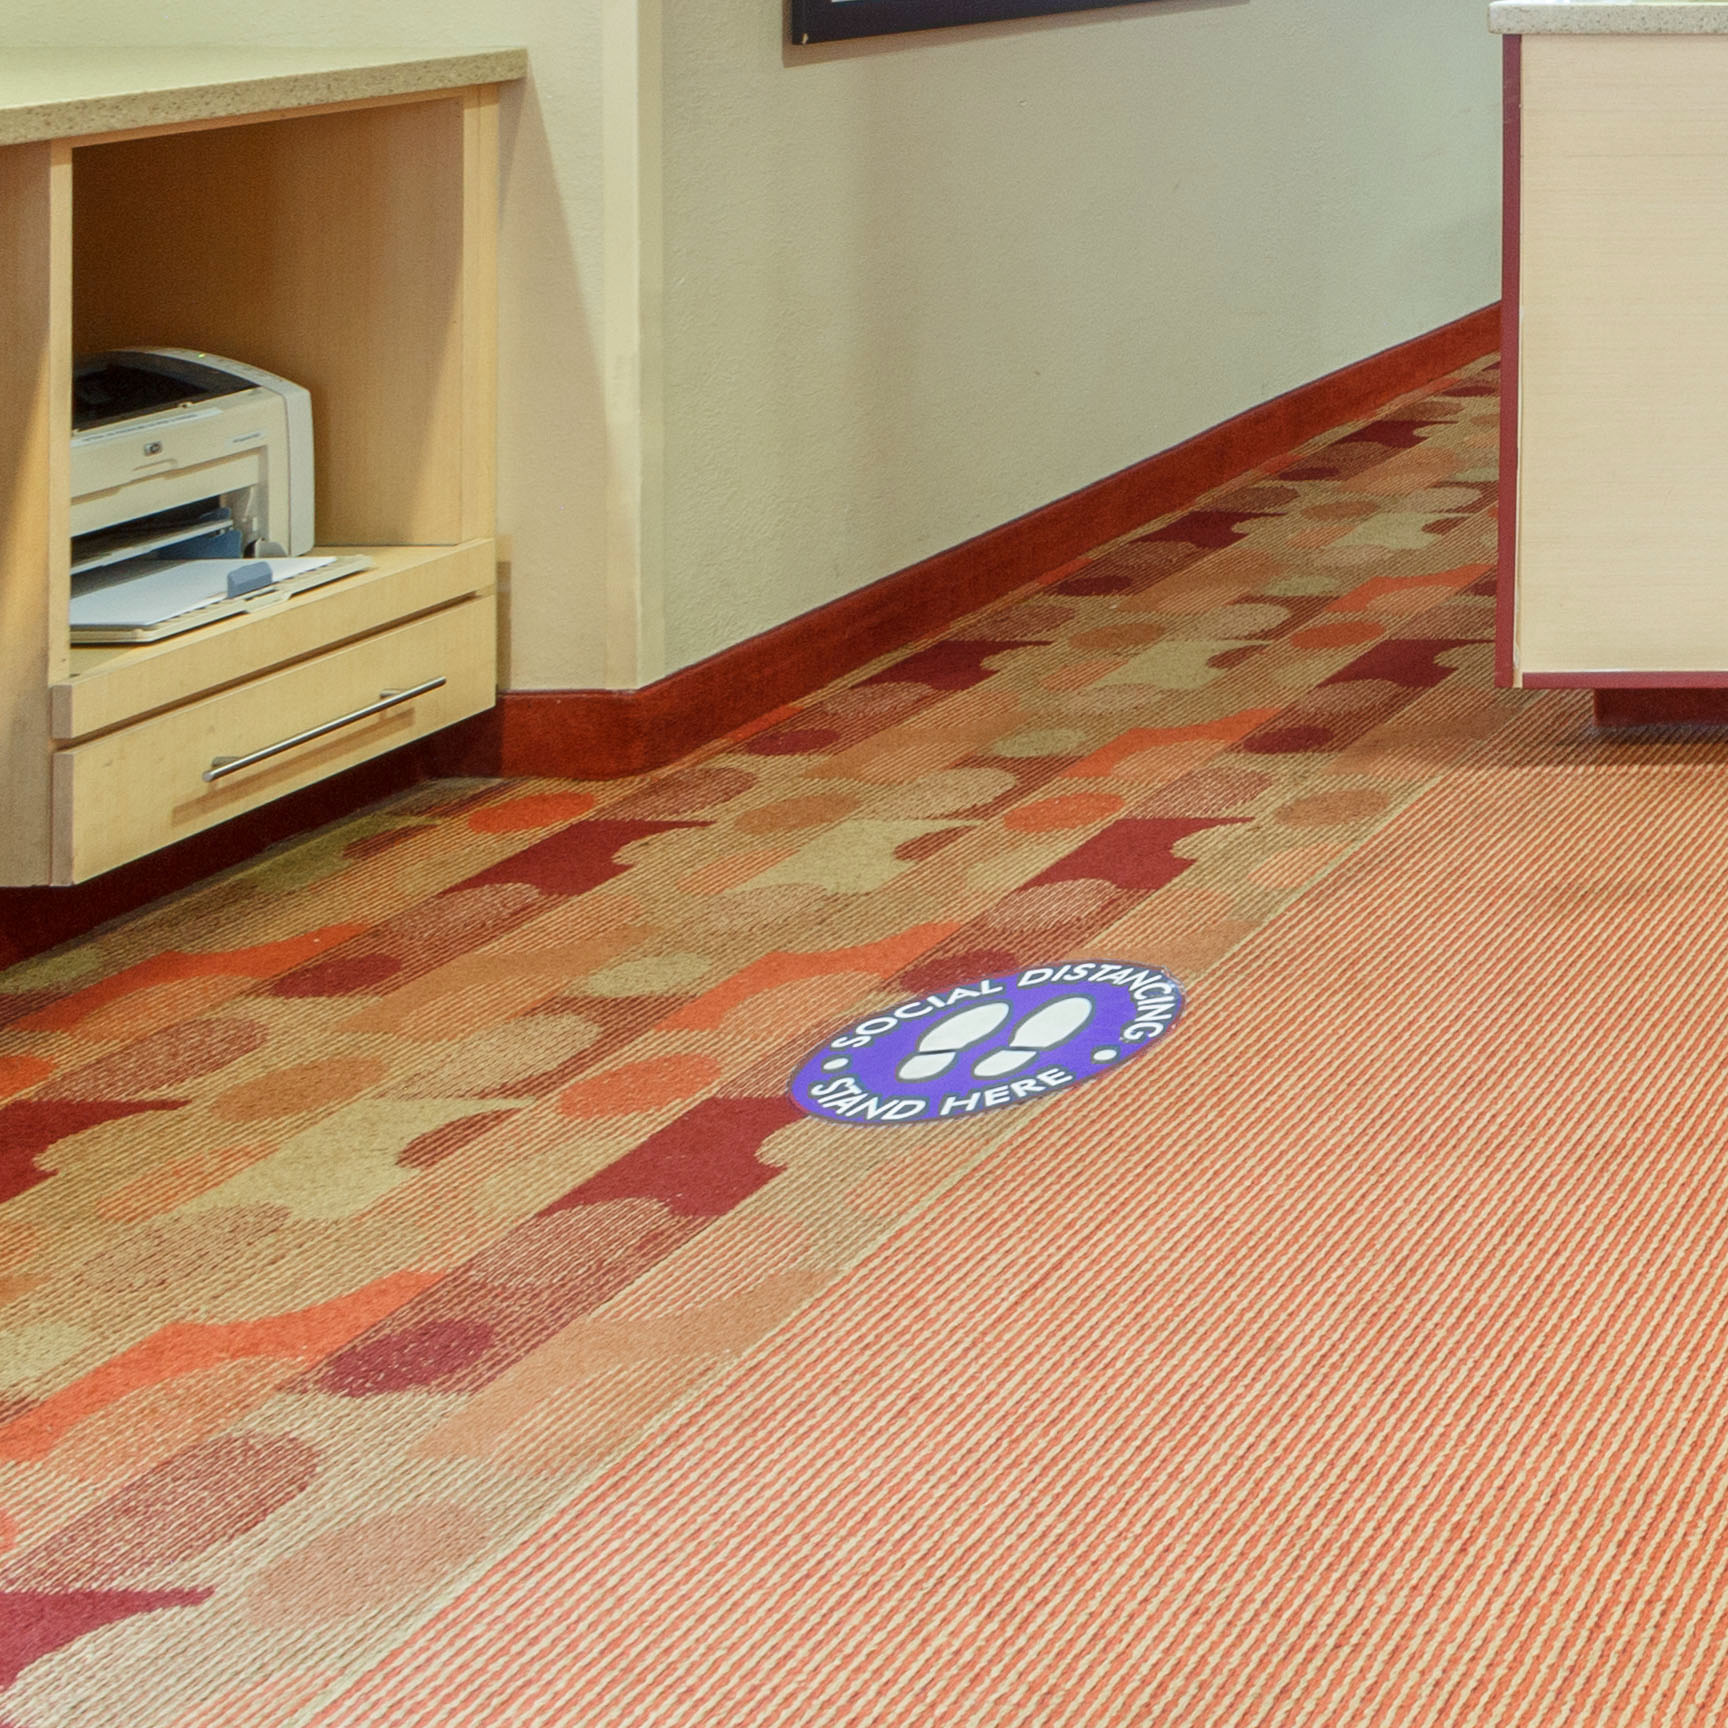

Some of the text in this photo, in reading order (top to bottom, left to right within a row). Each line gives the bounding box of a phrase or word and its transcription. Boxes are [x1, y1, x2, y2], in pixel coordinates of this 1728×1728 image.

[830, 962, 1174, 1049] SOCIAL DISTANCING
[810, 1067, 1073, 1121] STAND HERE
